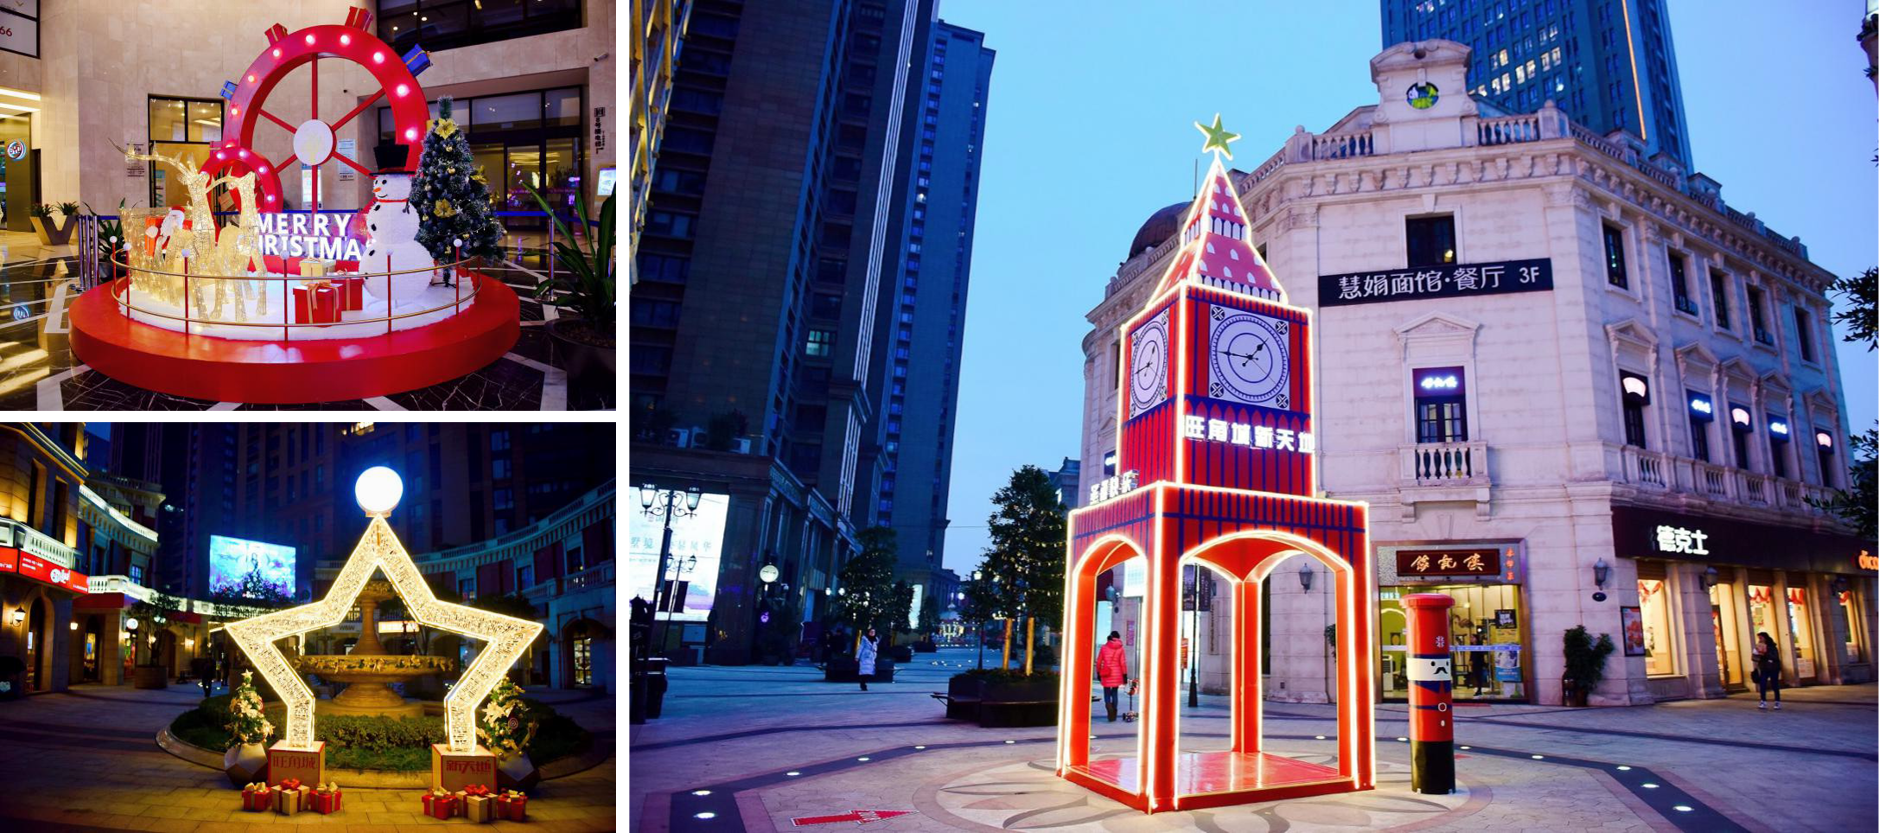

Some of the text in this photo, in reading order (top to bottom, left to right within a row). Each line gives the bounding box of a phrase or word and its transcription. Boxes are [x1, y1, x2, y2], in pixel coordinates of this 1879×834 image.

[257, 212, 352, 237] MERRY
[1518, 266, 1540, 284] 3F
[1185, 415, 1315, 454] 旺角城新天地
[1656, 525, 1709, 555] 德克士
